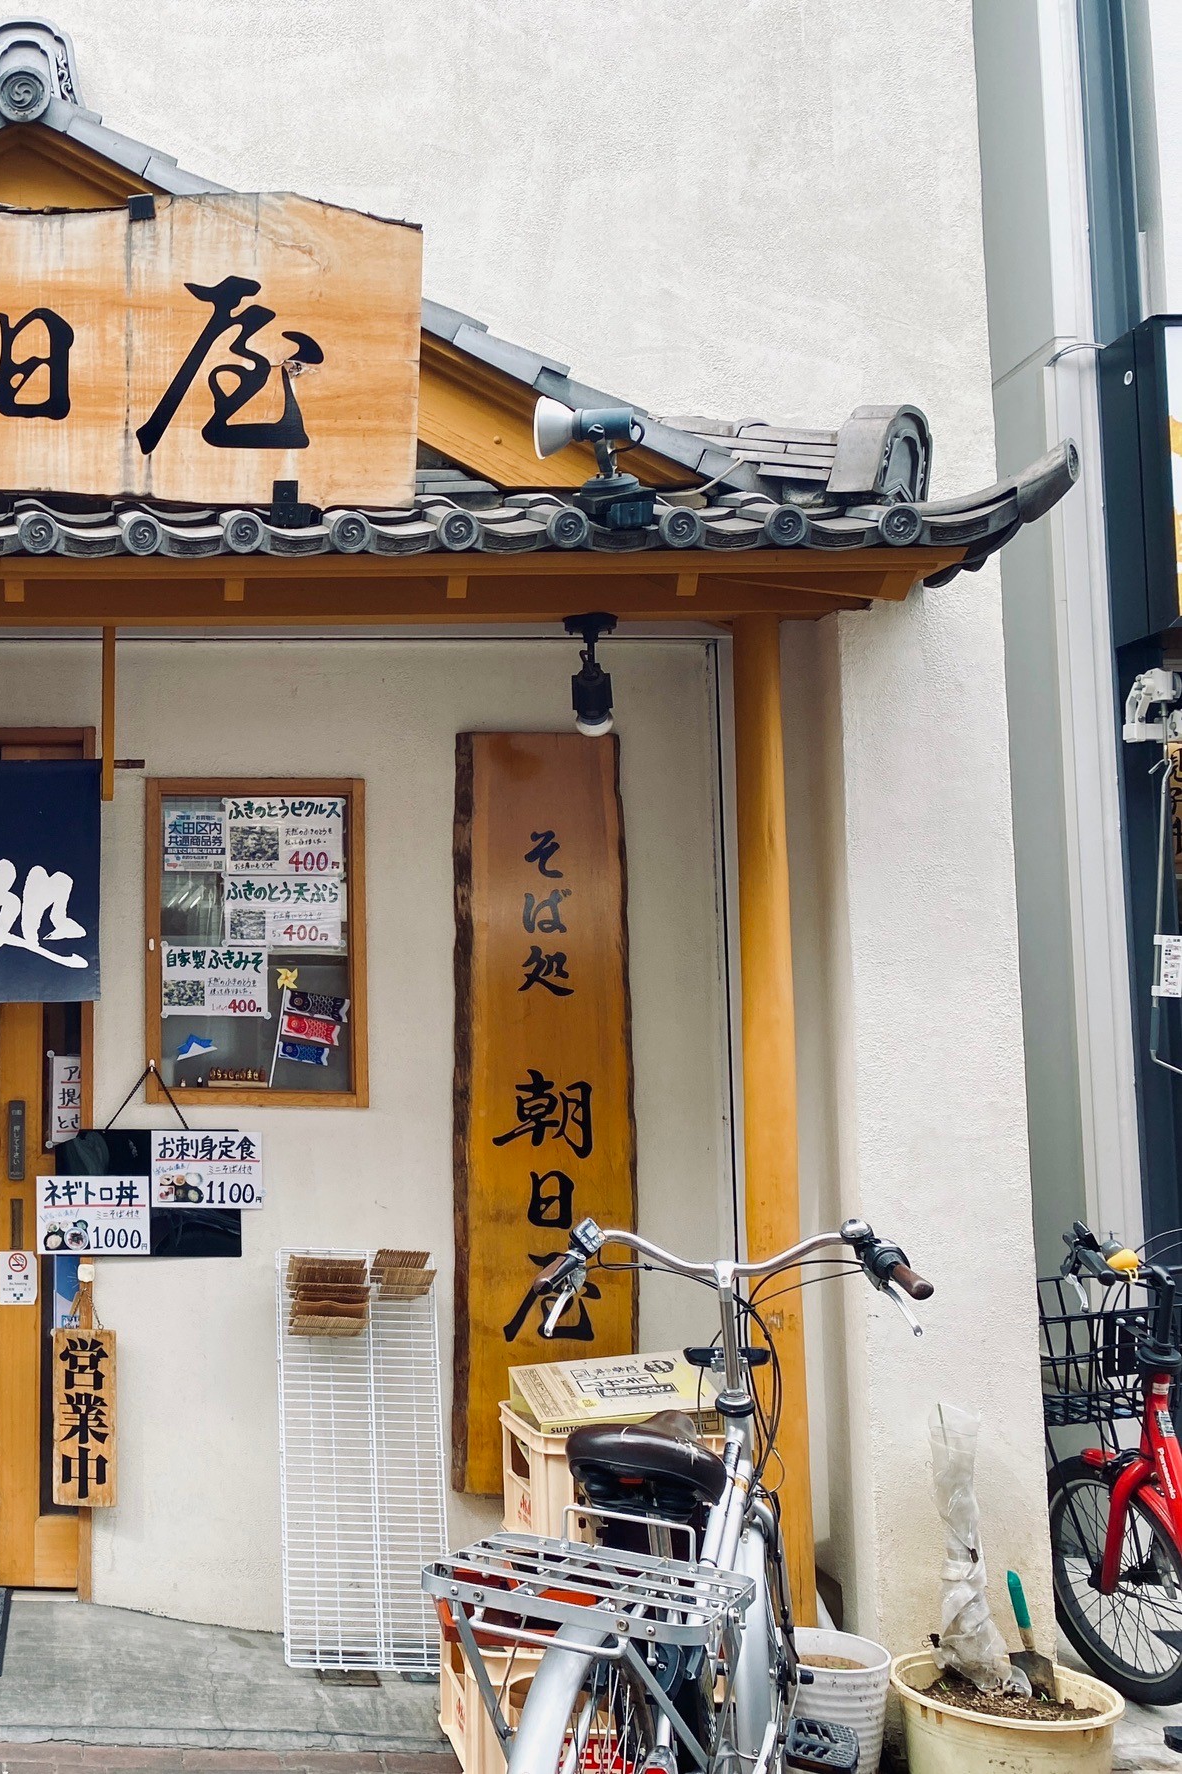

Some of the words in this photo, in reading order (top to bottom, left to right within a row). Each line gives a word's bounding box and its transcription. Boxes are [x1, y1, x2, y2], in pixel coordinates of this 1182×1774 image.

[228, 799, 341, 820] ふきのとうピクルス
[168, 821, 222, 835] 大田区内
[168, 835, 222, 847] 共通商品券
[226, 880, 339, 904] ふきのとう天ぷら
[517, 829, 576, 998] そば処
[283, 924, 328, 941] 400円
[63, 1065, 81, 1081] ア
[209, 1069, 259, 1081] いらっしゃいませ
[58, 1088, 81, 1106] 提
[158, 1135, 256, 1160] お刺身定食
[208, 1164, 253, 1175] ミニそば付き
[44, 1179, 139, 1207] ネギトロ丼
[96, 1209, 139, 1219] ミニそば付き
[492, 1069, 600, 1343] 朝日屋
[59, 1337, 109, 1499] 営業中
[550, 1425, 580, 1433] SUNTO
[1158, 1448, 1176, 1499] Panasonic
